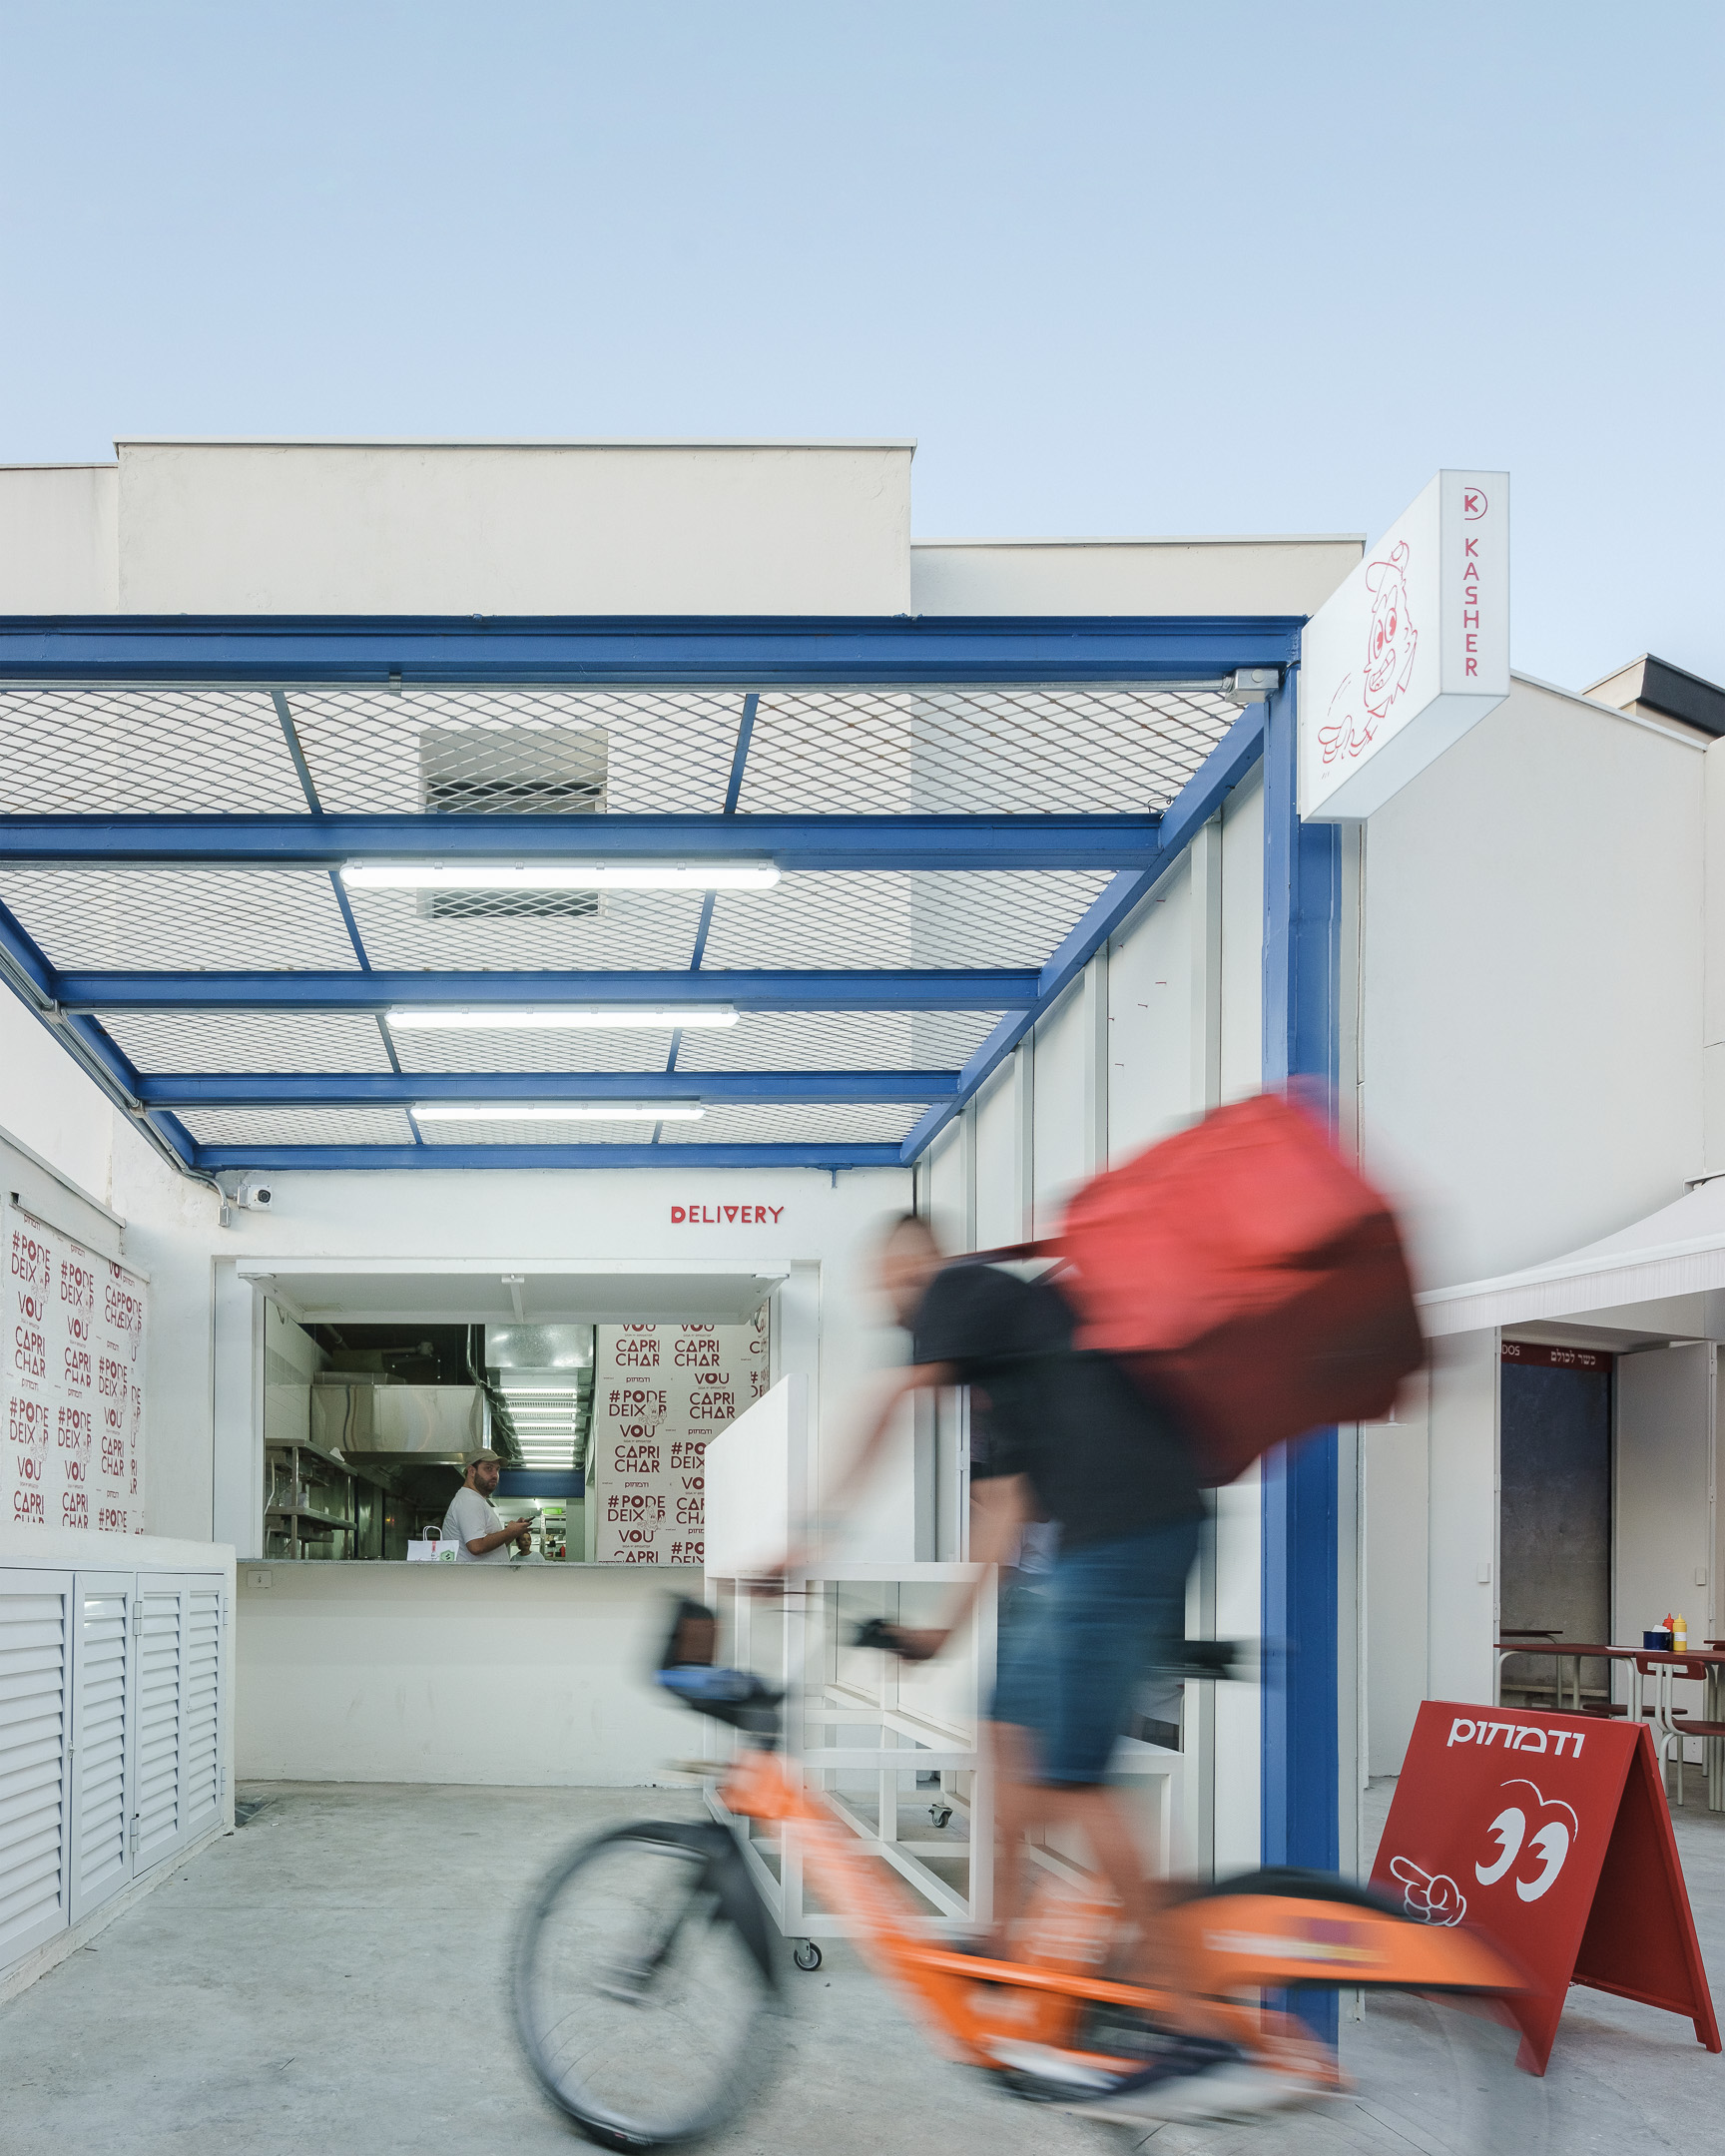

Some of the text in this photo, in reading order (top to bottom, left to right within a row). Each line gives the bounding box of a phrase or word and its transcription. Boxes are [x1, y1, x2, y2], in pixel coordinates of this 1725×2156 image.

[1463, 537, 1480, 677] KASHER
[671, 1205, 785, 1224] DELIVERY
[17, 1291, 43, 1322] VOU
[67, 1315, 89, 1342] VOU
[15, 1326, 46, 1357] CAPRI
[615, 1339, 720, 1352] CAPRI CAPRI
[15, 1348, 46, 1379] CHAR
[64, 1347, 92, 1373] CAPRI
[615, 1352, 720, 1366] CHAR CHAR
[694, 1372, 730, 1384] VOU
[689, 1391, 735, 1405] CAPRI
[103, 1405, 122, 1429] VOU
[609, 1403, 667, 1417] DEIXR
[689, 1405, 736, 1419] CHAR
[619, 1424, 656, 1438] VOU
[101, 1435, 125, 1458] CAPRI
[614, 1445, 660, 1459] CAPRI
[16, 1455, 42, 1481] VOU
[64, 1459, 86, 1482] VOU
[101, 1455, 125, 1477] CHAR
[614, 1459, 660, 1473] CHAR
[13, 1490, 45, 1515] CAPRI
[62, 1491, 89, 1513] CAPRI
[607, 1508, 666, 1523] DEIXR
[618, 1529, 654, 1543] VOU
